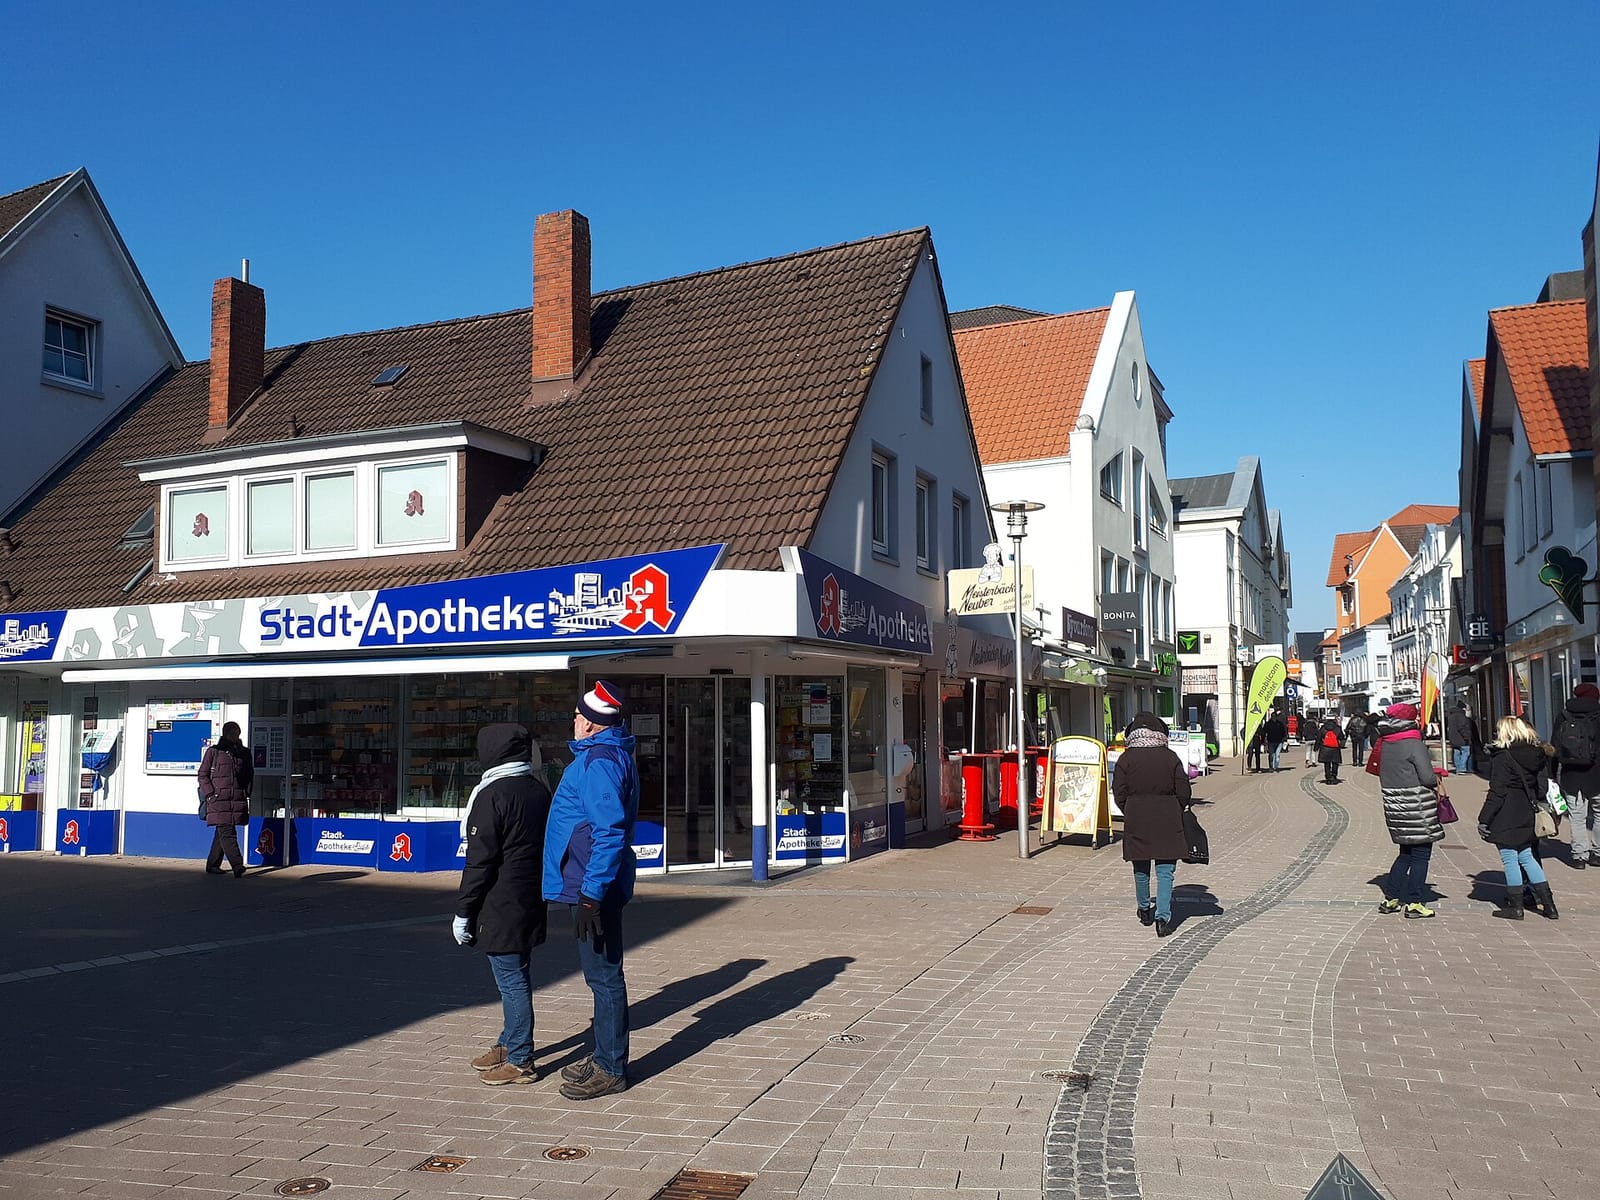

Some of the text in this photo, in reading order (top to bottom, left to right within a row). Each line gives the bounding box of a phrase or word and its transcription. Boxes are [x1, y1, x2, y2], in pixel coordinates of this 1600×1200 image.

[961, 583, 1023, 601] Meisterbäck
[867, 605, 928, 645] Apotheke
[1103, 610, 1136, 621] BONITA
[1257, 662, 1280, 698] mobilcom
[1263, 681, 1278, 702] debitel
